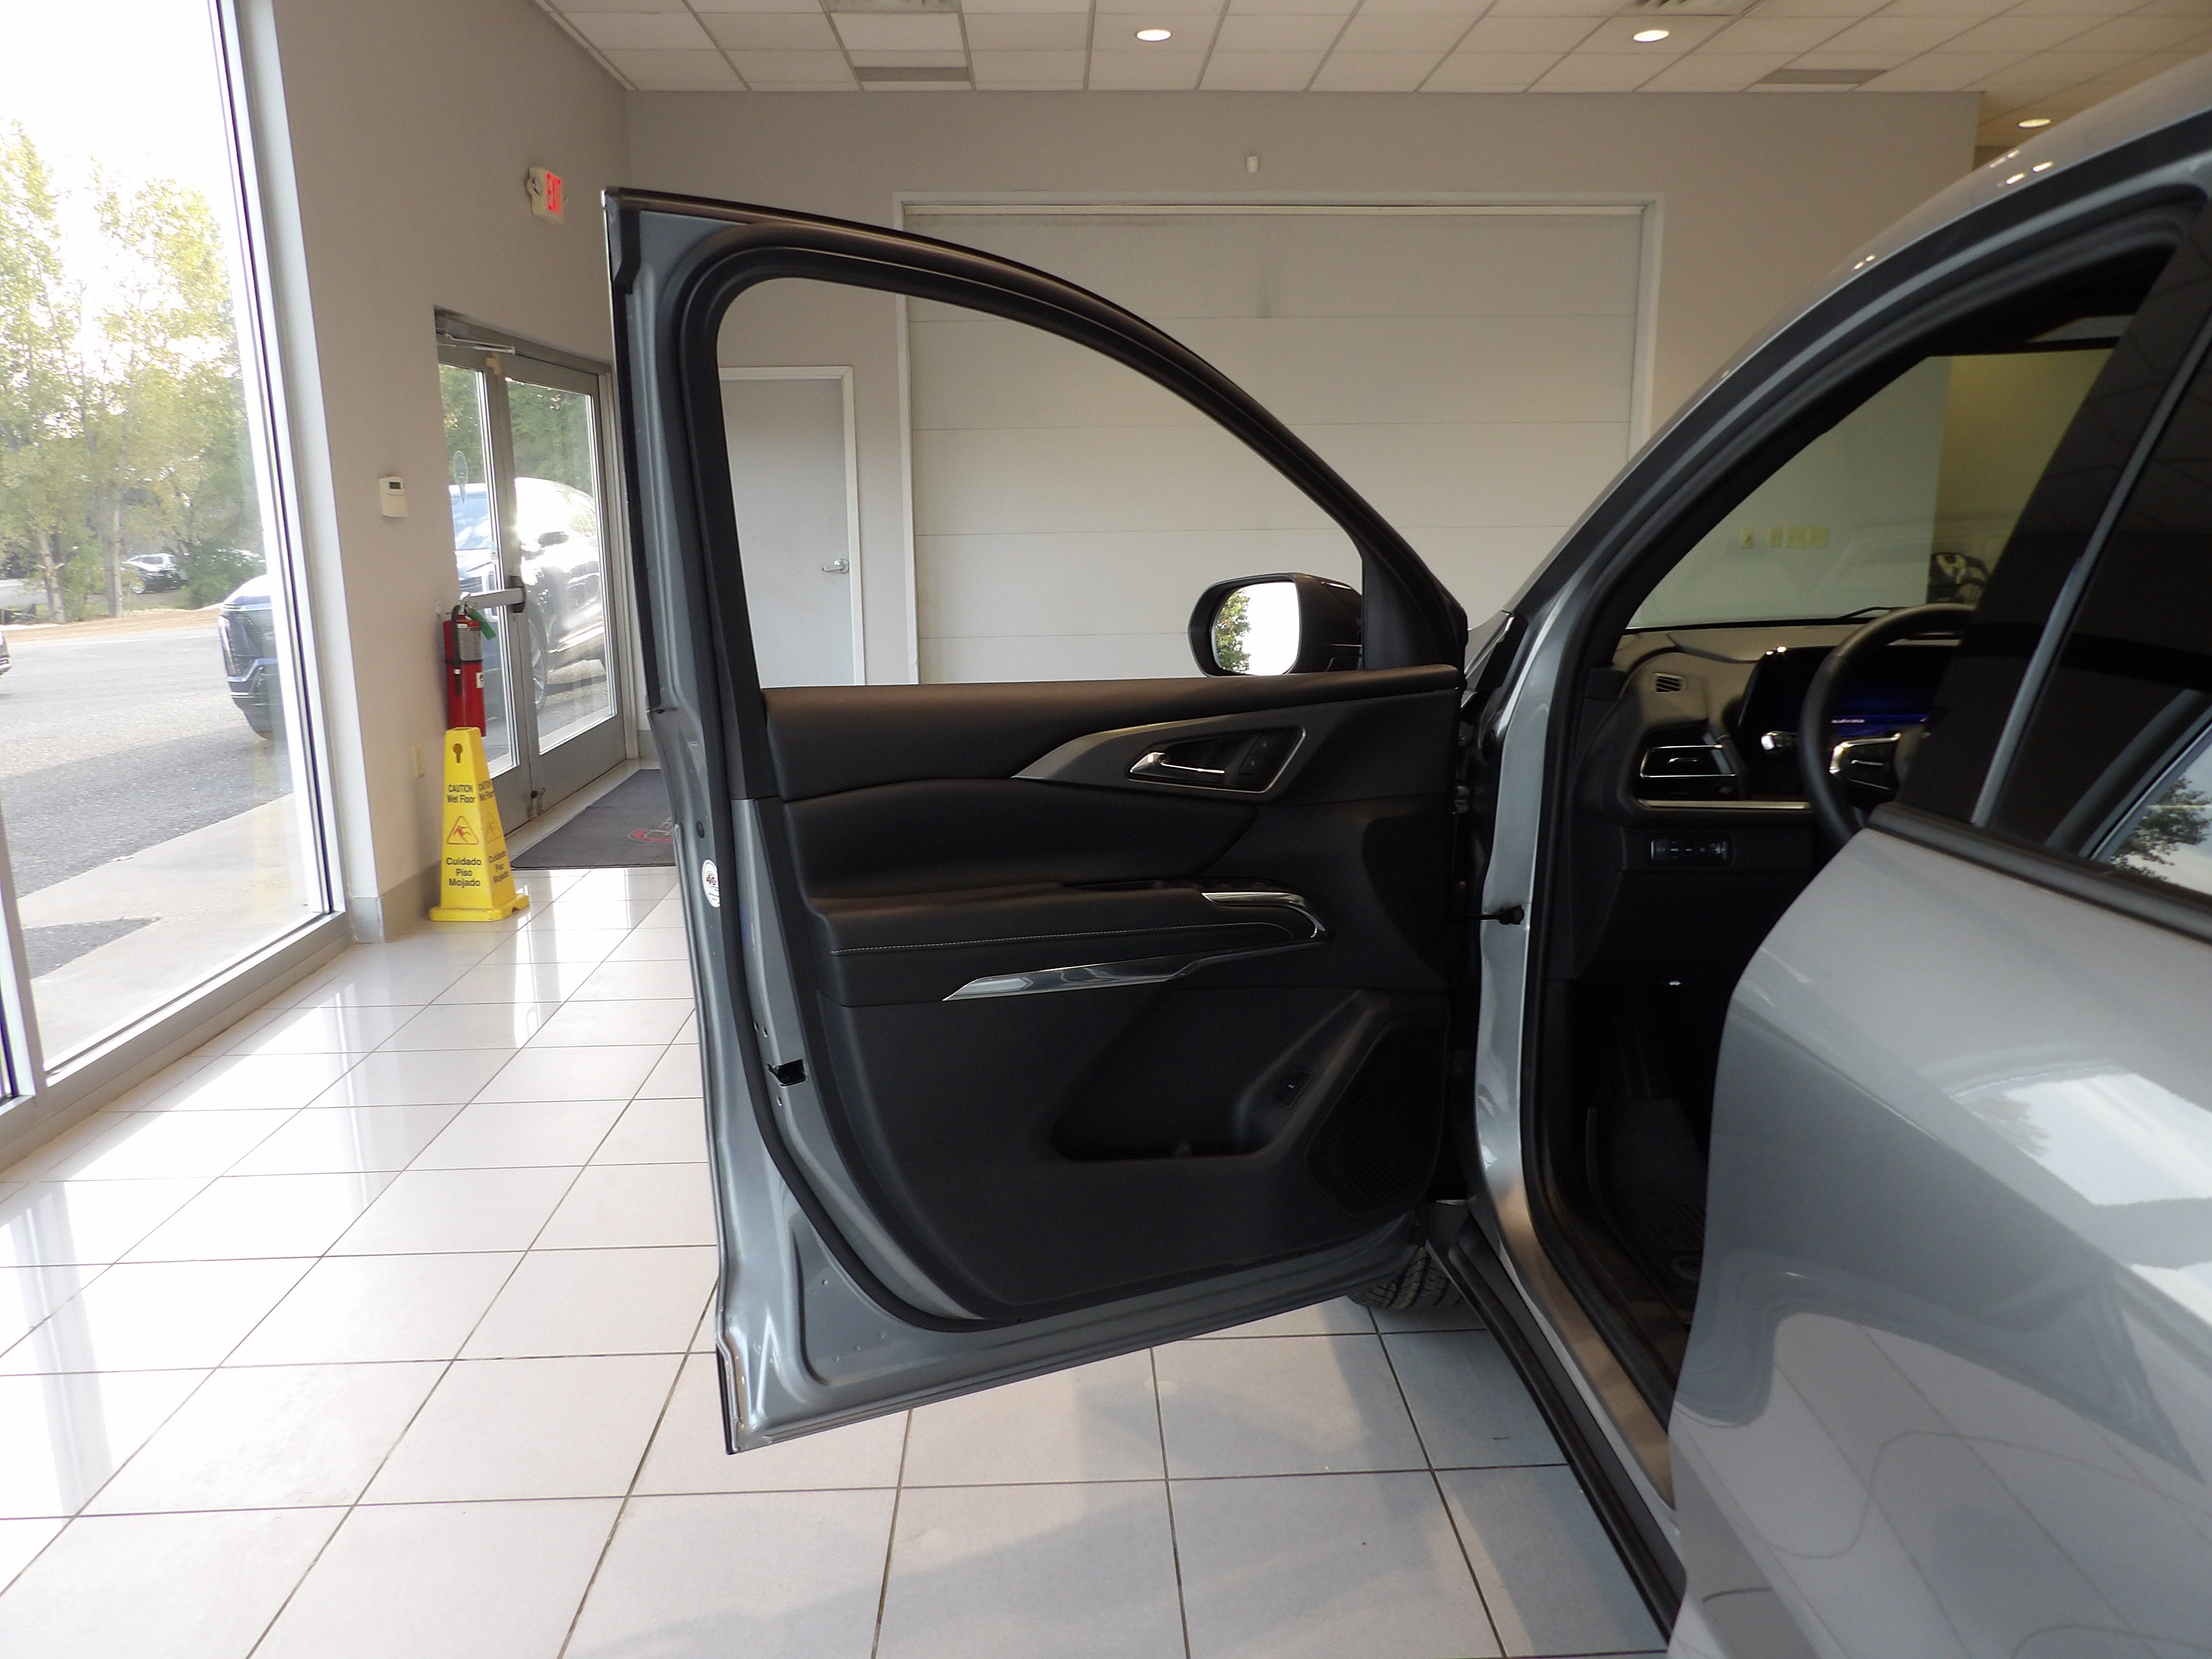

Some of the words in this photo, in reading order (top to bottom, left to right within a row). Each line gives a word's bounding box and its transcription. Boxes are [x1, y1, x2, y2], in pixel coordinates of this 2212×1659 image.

[448, 784, 473, 793] CAUTION
[447, 794, 458, 803] Wet
[460, 794, 475, 803] Floor
[446, 857, 481, 866] Cuidado
[449, 878, 481, 888] Mojado
